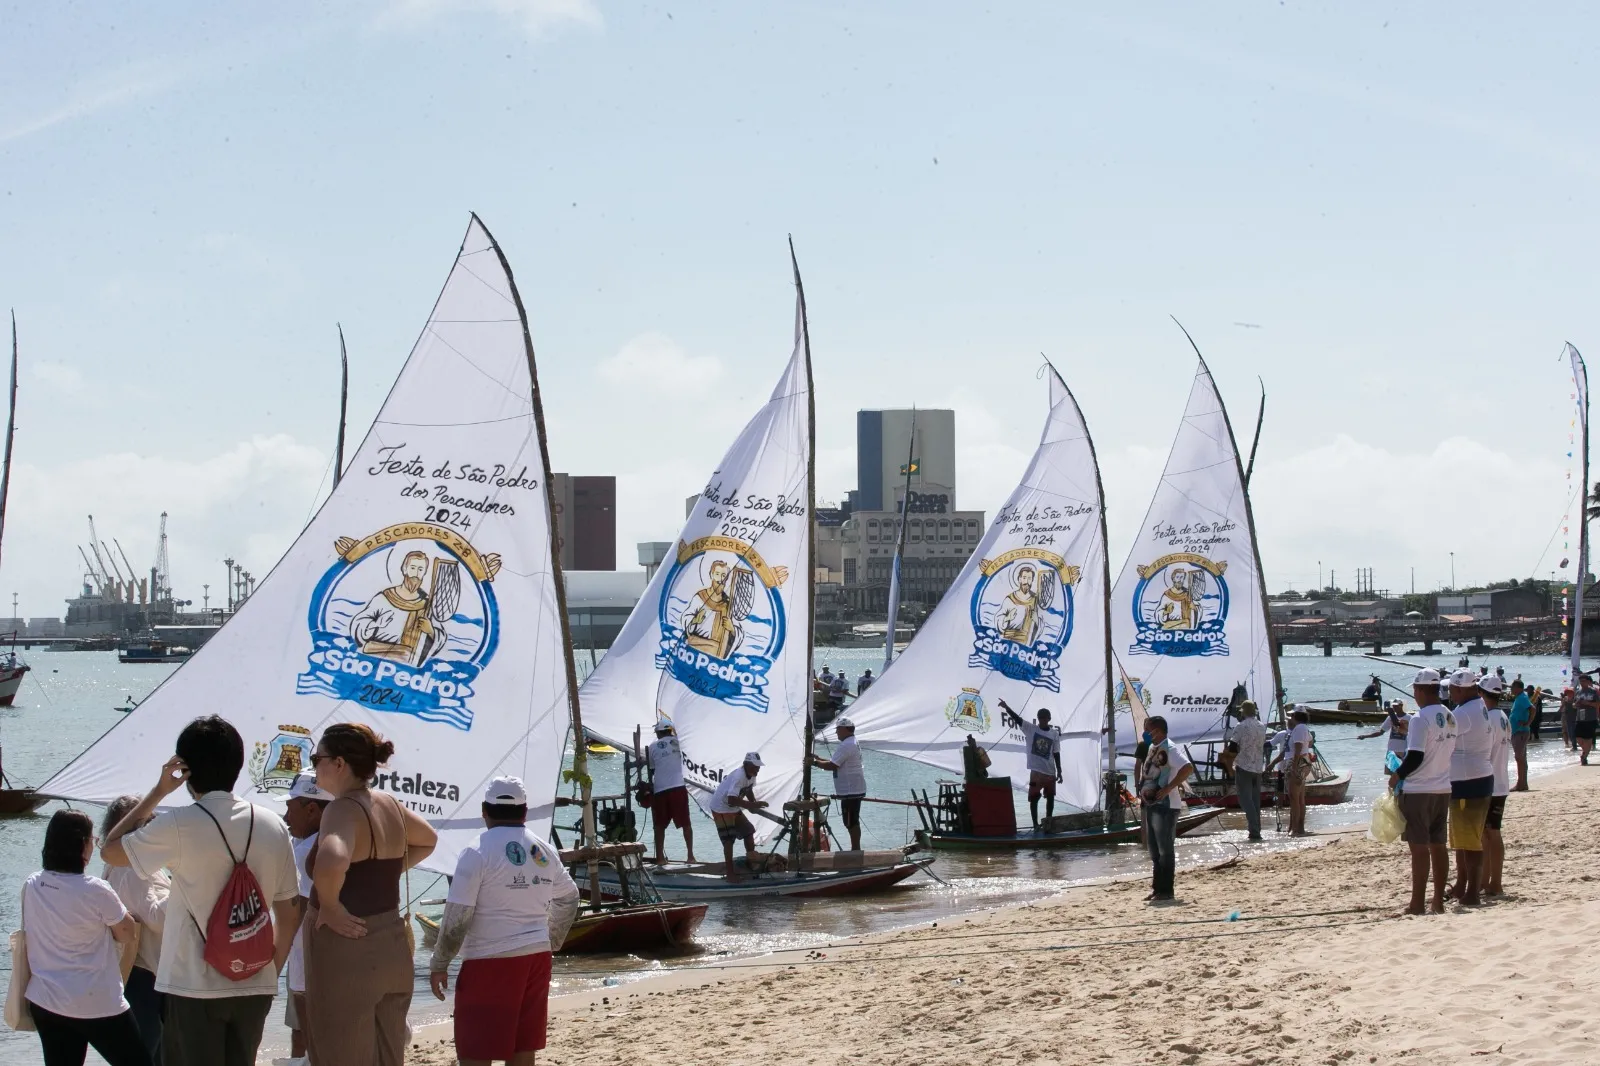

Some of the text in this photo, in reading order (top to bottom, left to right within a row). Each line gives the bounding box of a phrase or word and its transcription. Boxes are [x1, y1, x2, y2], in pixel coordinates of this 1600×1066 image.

[368, 443, 538, 491] Festa de São Pedro
[400, 482, 515, 516] dos Pescadores
[722, 489, 741, 508] de
[744, 494, 773, 511] São
[777, 494, 805, 517] Pedro
[424, 505, 472, 532] 2024
[706, 507, 786, 534] dos Pescadores
[995, 503, 1093, 525] Festa de São Pedro
[721, 523, 759, 544] 2024
[1009, 522, 1071, 535] dos Pescadores
[1152, 520, 1236, 541] Festa de São Pedro
[365, 526, 472, 559] PESCADORES Z-8
[691, 538, 748, 556] PESCADORES
[1023, 534, 1056, 547] 2024
[1169, 536, 1231, 546] dos Pescadores
[1183, 544, 1211, 554] 2024
[991, 550, 1046, 571] PESCADORES
[1145, 629, 1216, 642] São Pedro
[669, 639, 754, 687] São Pedro
[982, 637, 1050, 669] São Pedro
[323, 649, 456, 698] São Pedro
[1002, 661, 1027, 677] 2024
[358, 683, 404, 709] 2024
[687, 674, 719, 696] 2024
[1163, 694, 1229, 706] Fortaleza
[681, 751, 727, 783] Fortal
[265, 778, 292, 788] FORTITU
[369, 771, 460, 802] ortaleza
[399, 799, 443, 816] ITURA
